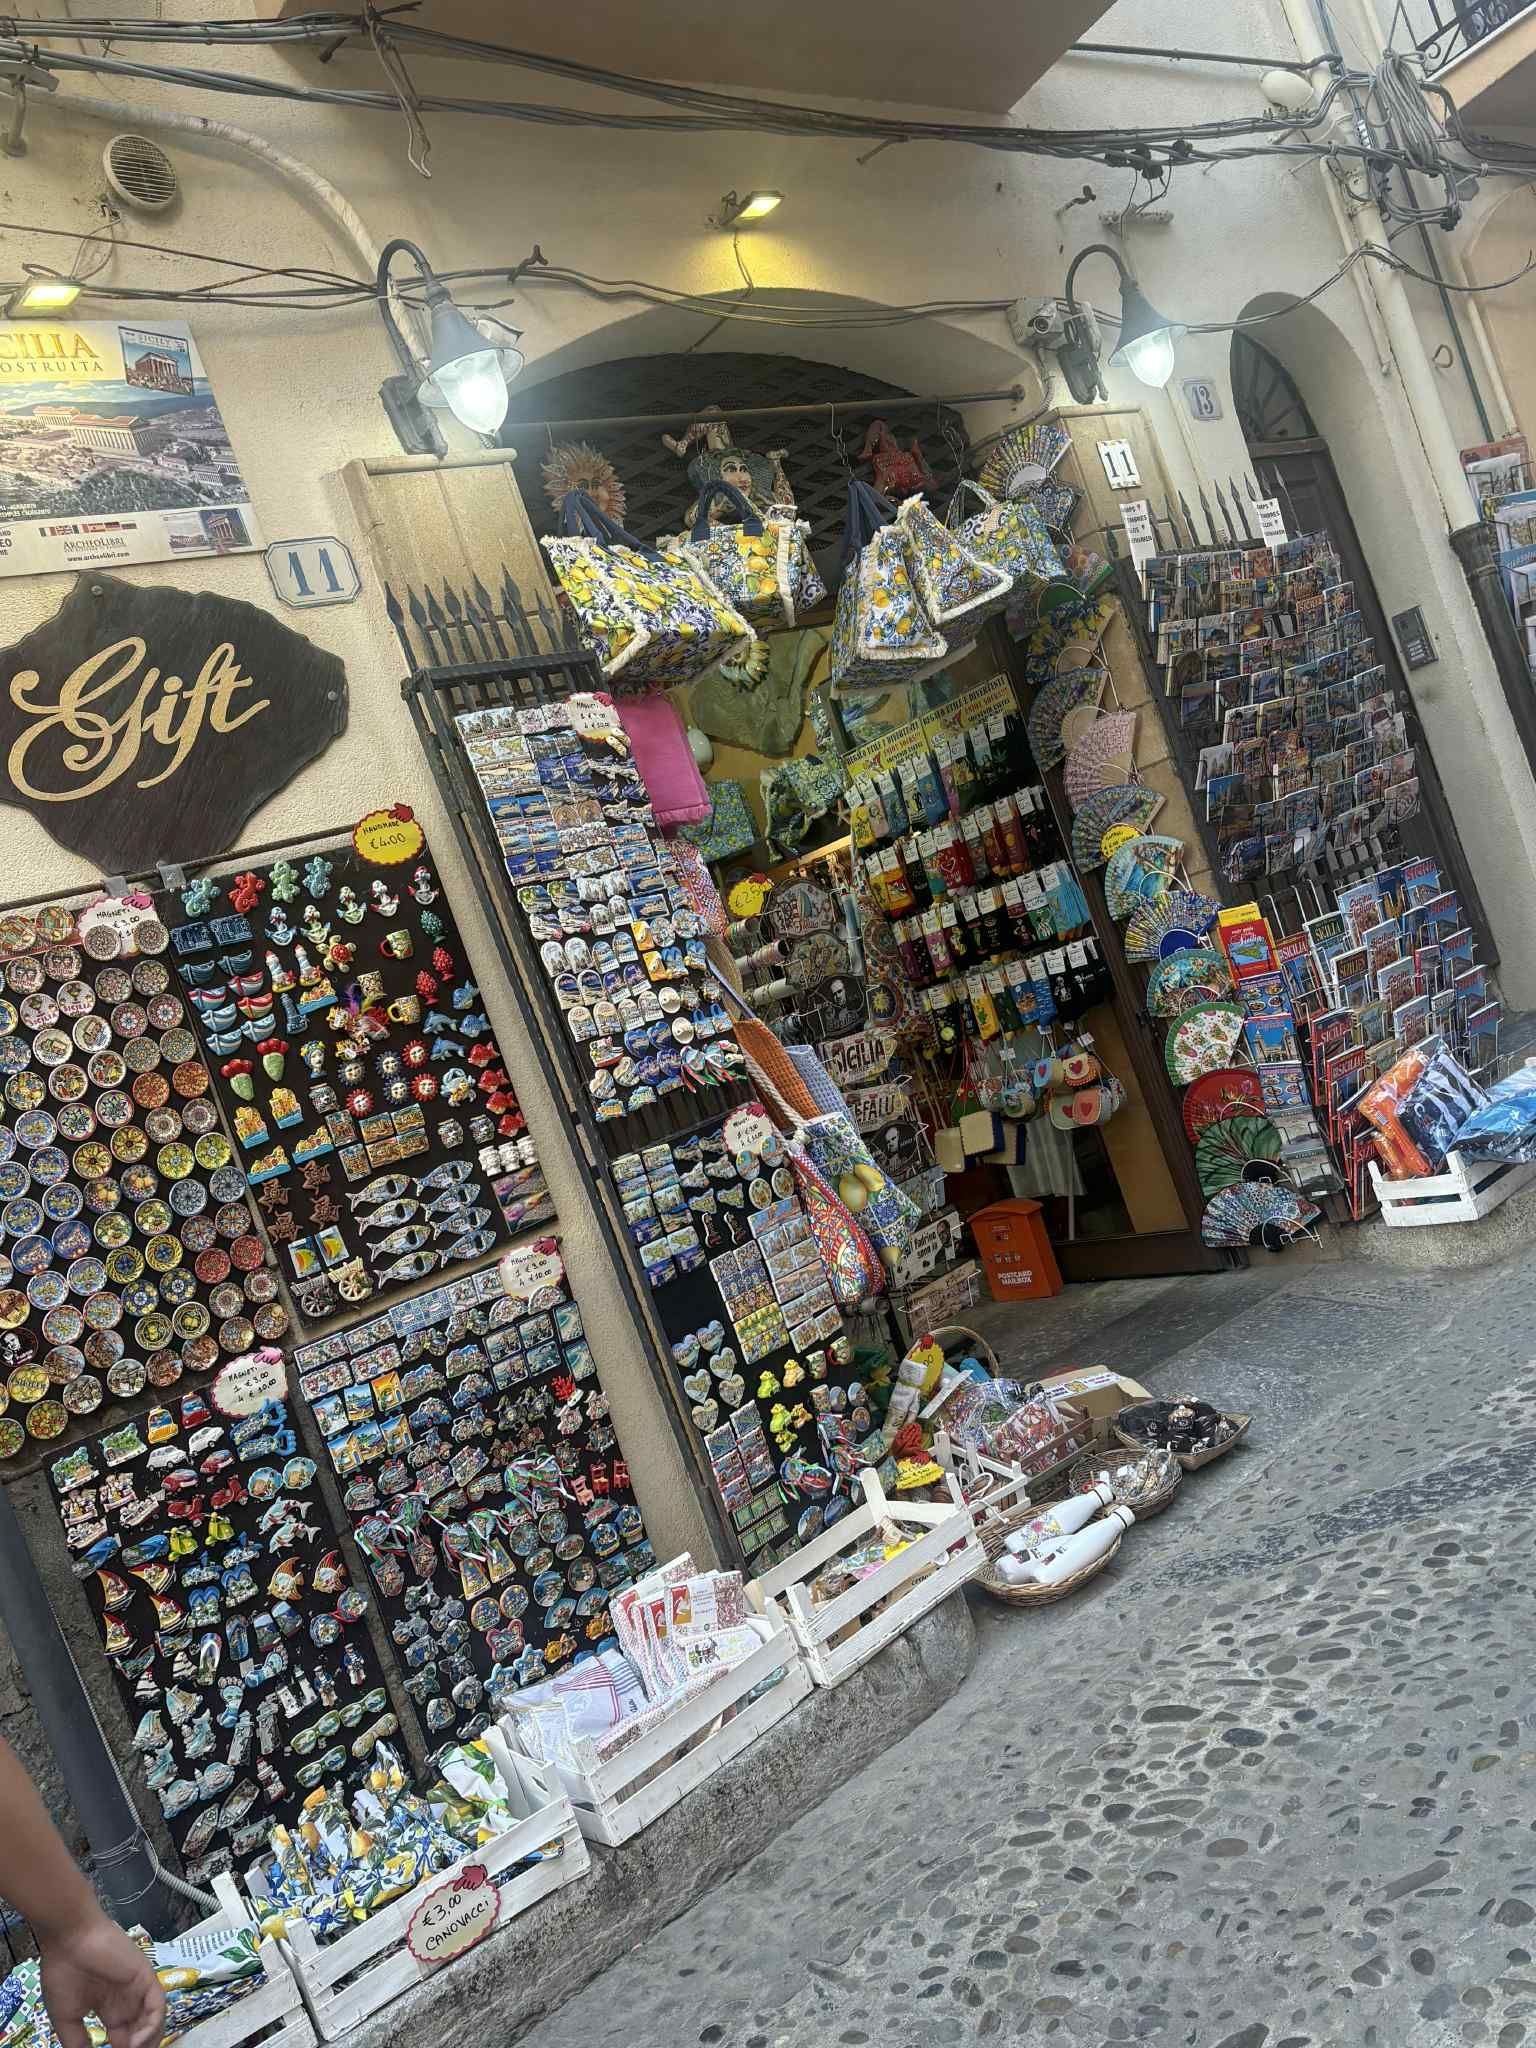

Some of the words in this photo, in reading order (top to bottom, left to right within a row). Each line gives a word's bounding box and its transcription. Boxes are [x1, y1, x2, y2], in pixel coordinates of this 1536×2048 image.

[1103, 449, 1136, 479] 11
[287, 546, 345, 597] 11
[8, 636, 271, 801] Gift
[362, 820, 400, 836] HANDMADE
[997, 1270, 1033, 1280] POSTCARD
[421, 1893, 463, 1927] €3,00
[425, 1895, 490, 1951] CANOVACCI
